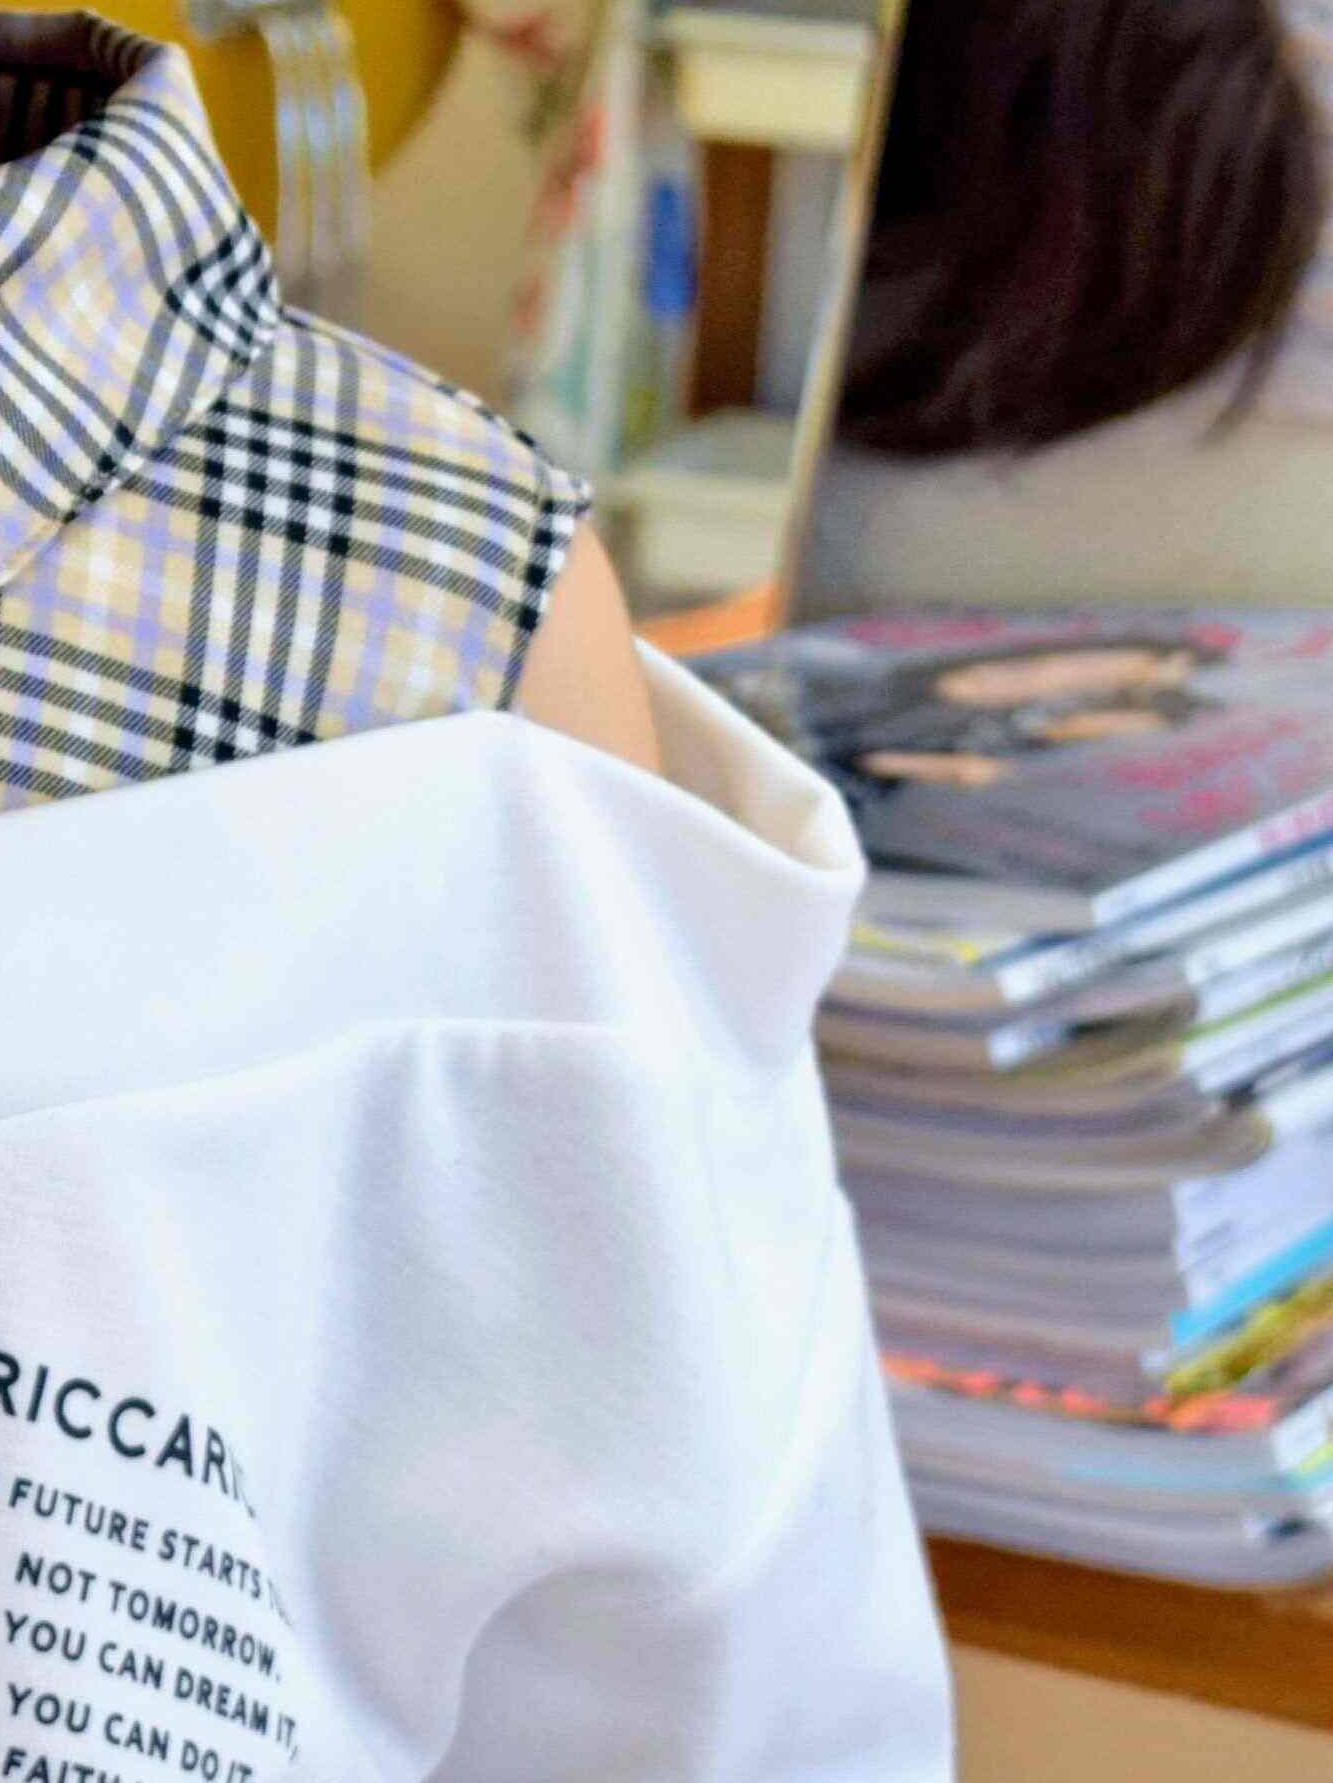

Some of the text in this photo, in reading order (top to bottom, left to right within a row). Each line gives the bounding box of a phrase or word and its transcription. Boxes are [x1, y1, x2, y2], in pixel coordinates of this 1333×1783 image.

[8, 1476, 150, 1553] FUTURE
[157, 1528, 262, 1601] STARTS
[14, 1551, 97, 1604] NOT
[108, 1580, 280, 1682] TOMORROW.
[4, 1609, 87, 1663] YOU
[97, 1640, 165, 1691] CAN
[173, 1666, 269, 1737] DREAM
[275, 1712, 298, 1761] IT,
[6, 1682, 91, 1734] YOU
[103, 1713, 170, 1762] CAN
[180, 1739, 220, 1783] DO
